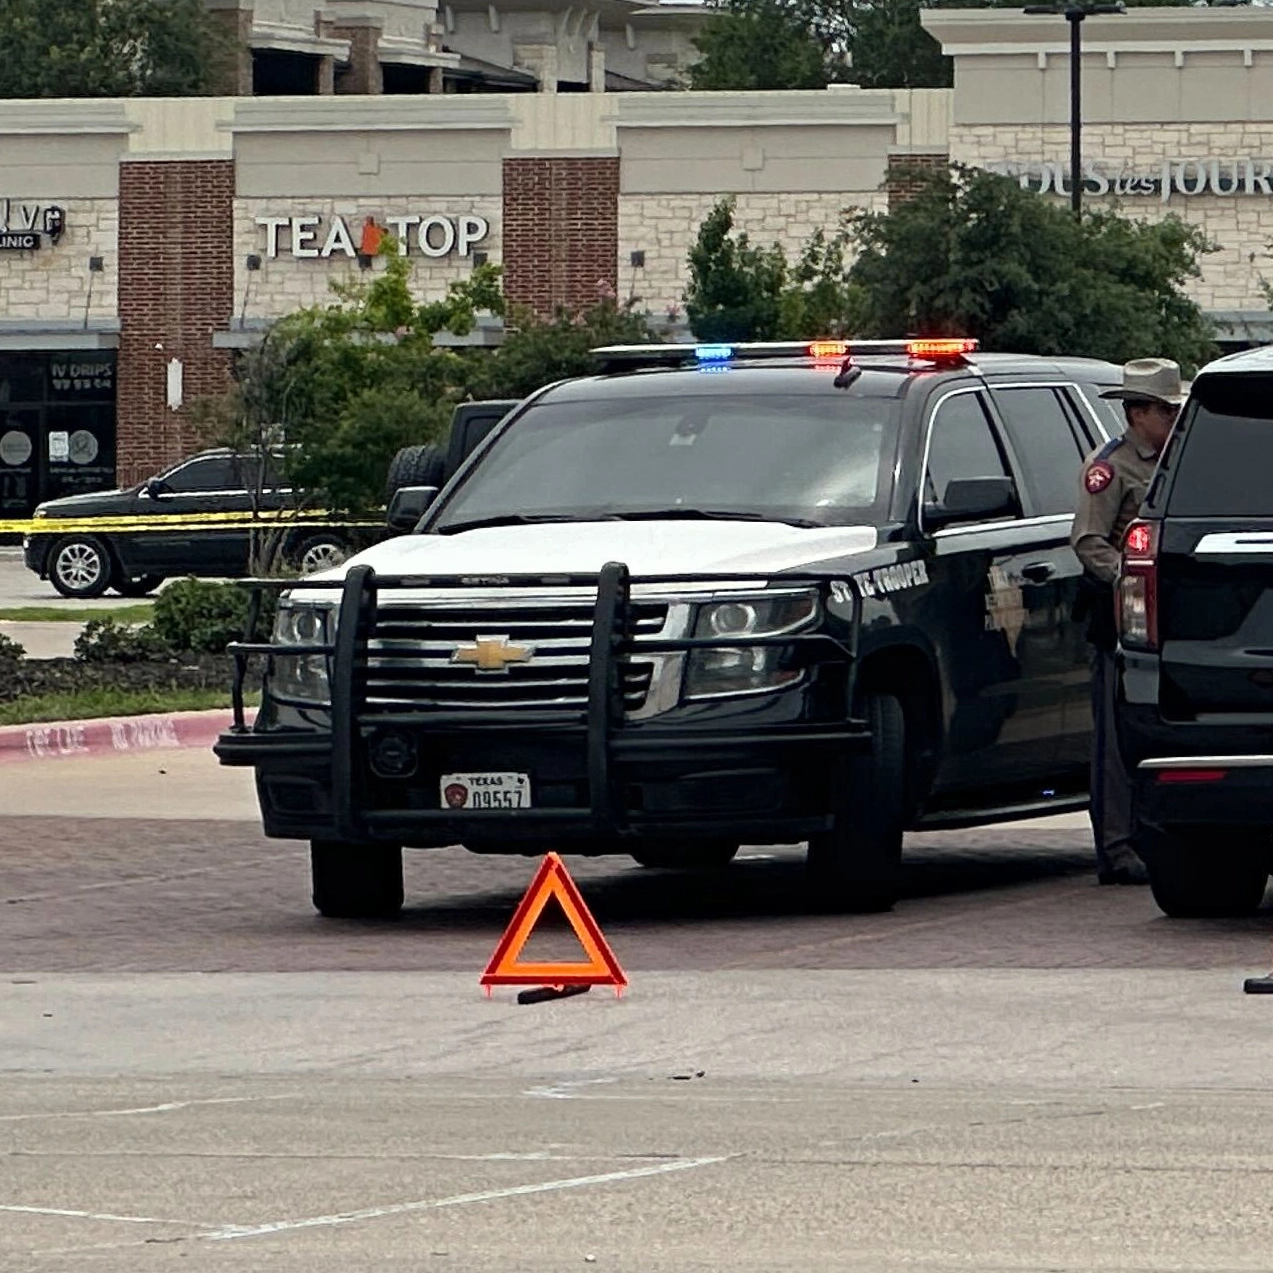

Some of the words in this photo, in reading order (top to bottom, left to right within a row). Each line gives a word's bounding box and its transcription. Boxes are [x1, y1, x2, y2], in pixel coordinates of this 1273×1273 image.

[1113, 160, 1156, 196] les
[0, 236, 34, 247] INIC
[255, 215, 357, 258] TEA
[386, 215, 488, 258] TOP
[468, 777, 503, 786] TEXAS
